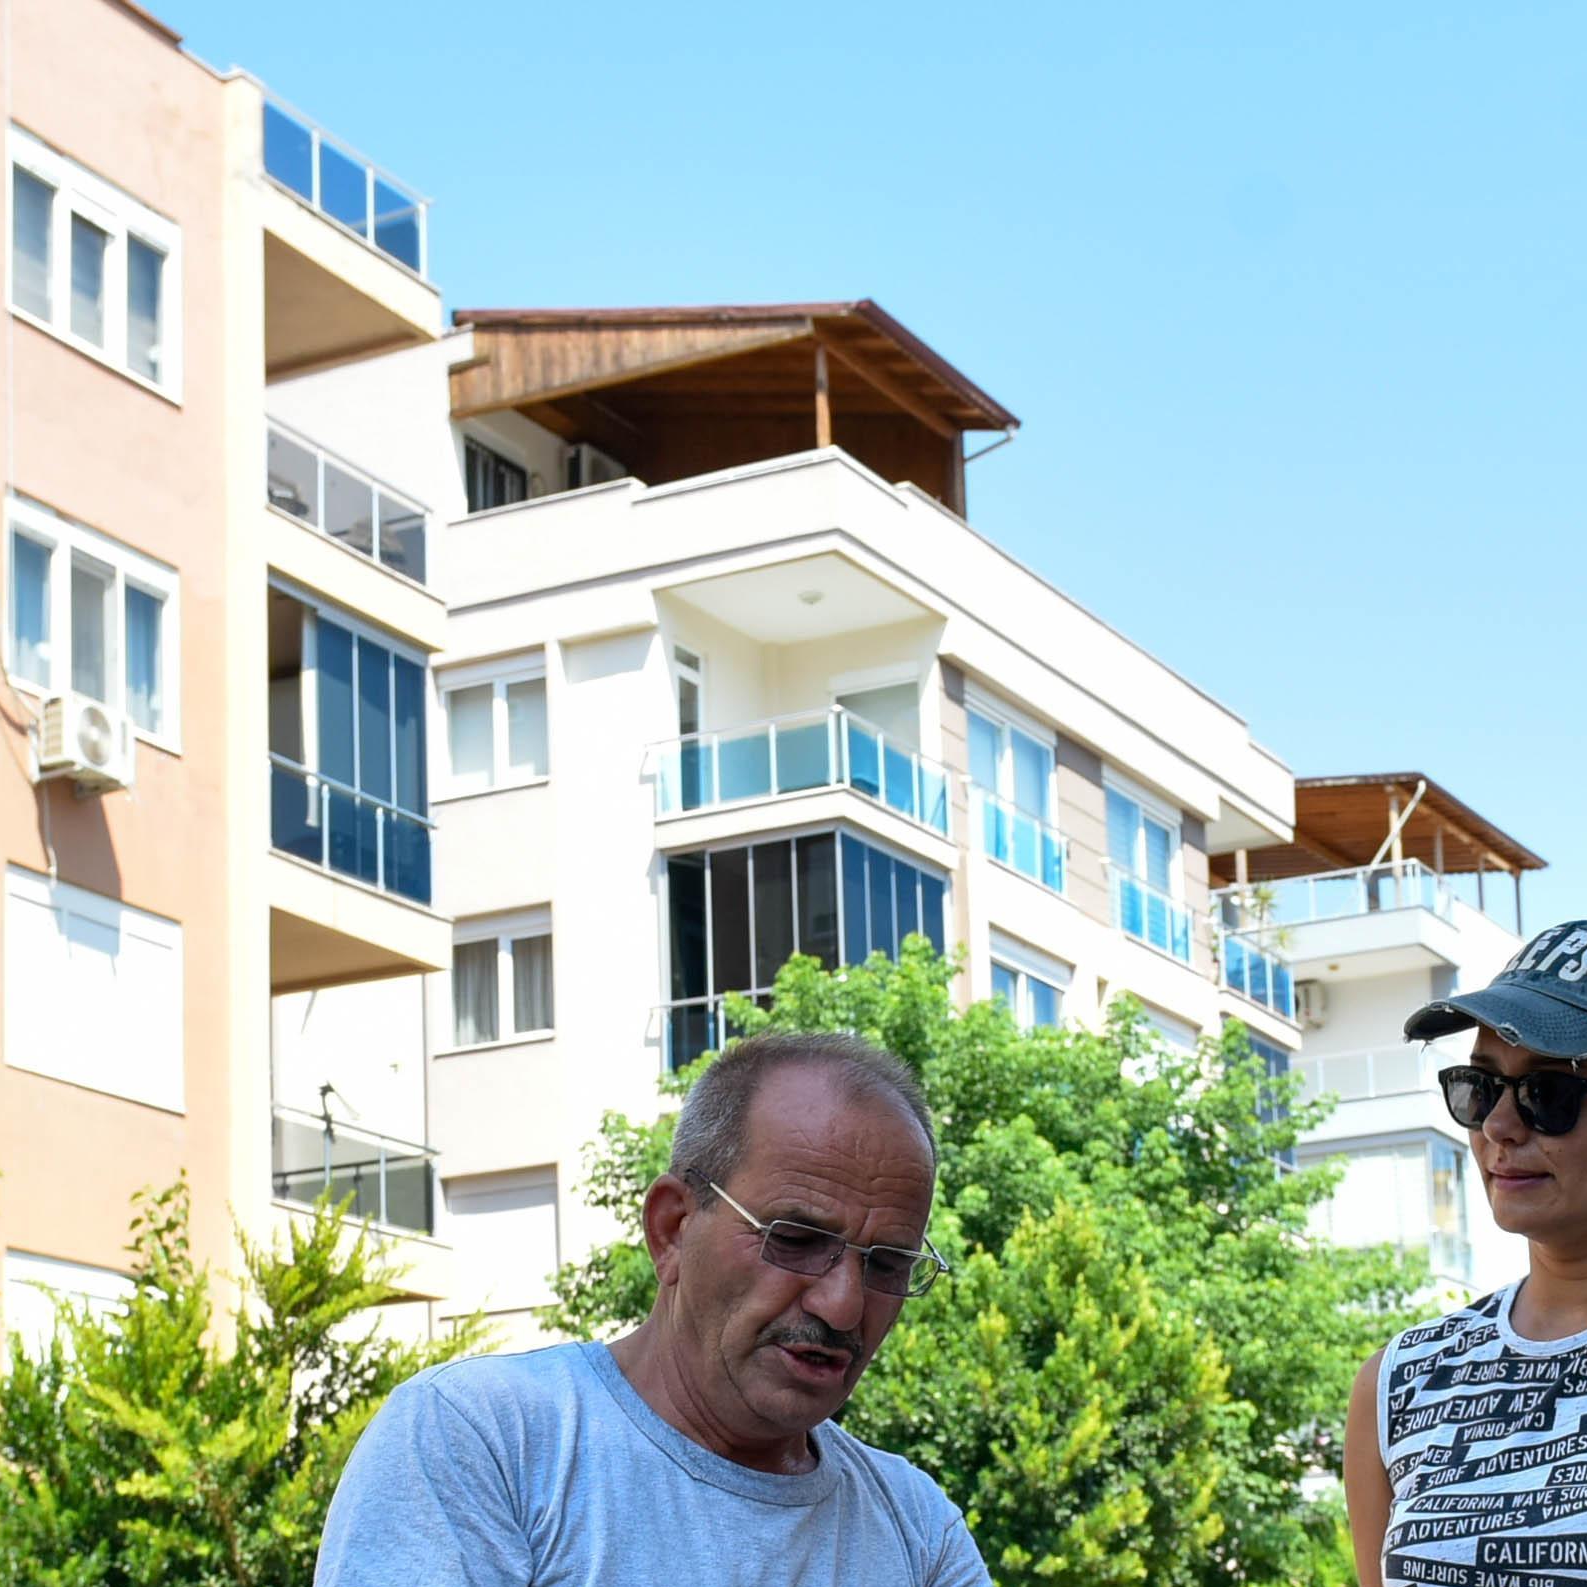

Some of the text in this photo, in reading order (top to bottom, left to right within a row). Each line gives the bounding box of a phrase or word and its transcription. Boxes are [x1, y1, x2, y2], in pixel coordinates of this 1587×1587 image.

[1425, 1464, 1468, 1490] SURF
[1413, 1495, 1504, 1513] CALIFORNIA
[1512, 1486, 1555, 1508] WAVE
[1408, 1510, 1528, 1540] ADVENTURES
[1402, 1559, 1468, 1585] SURFING
